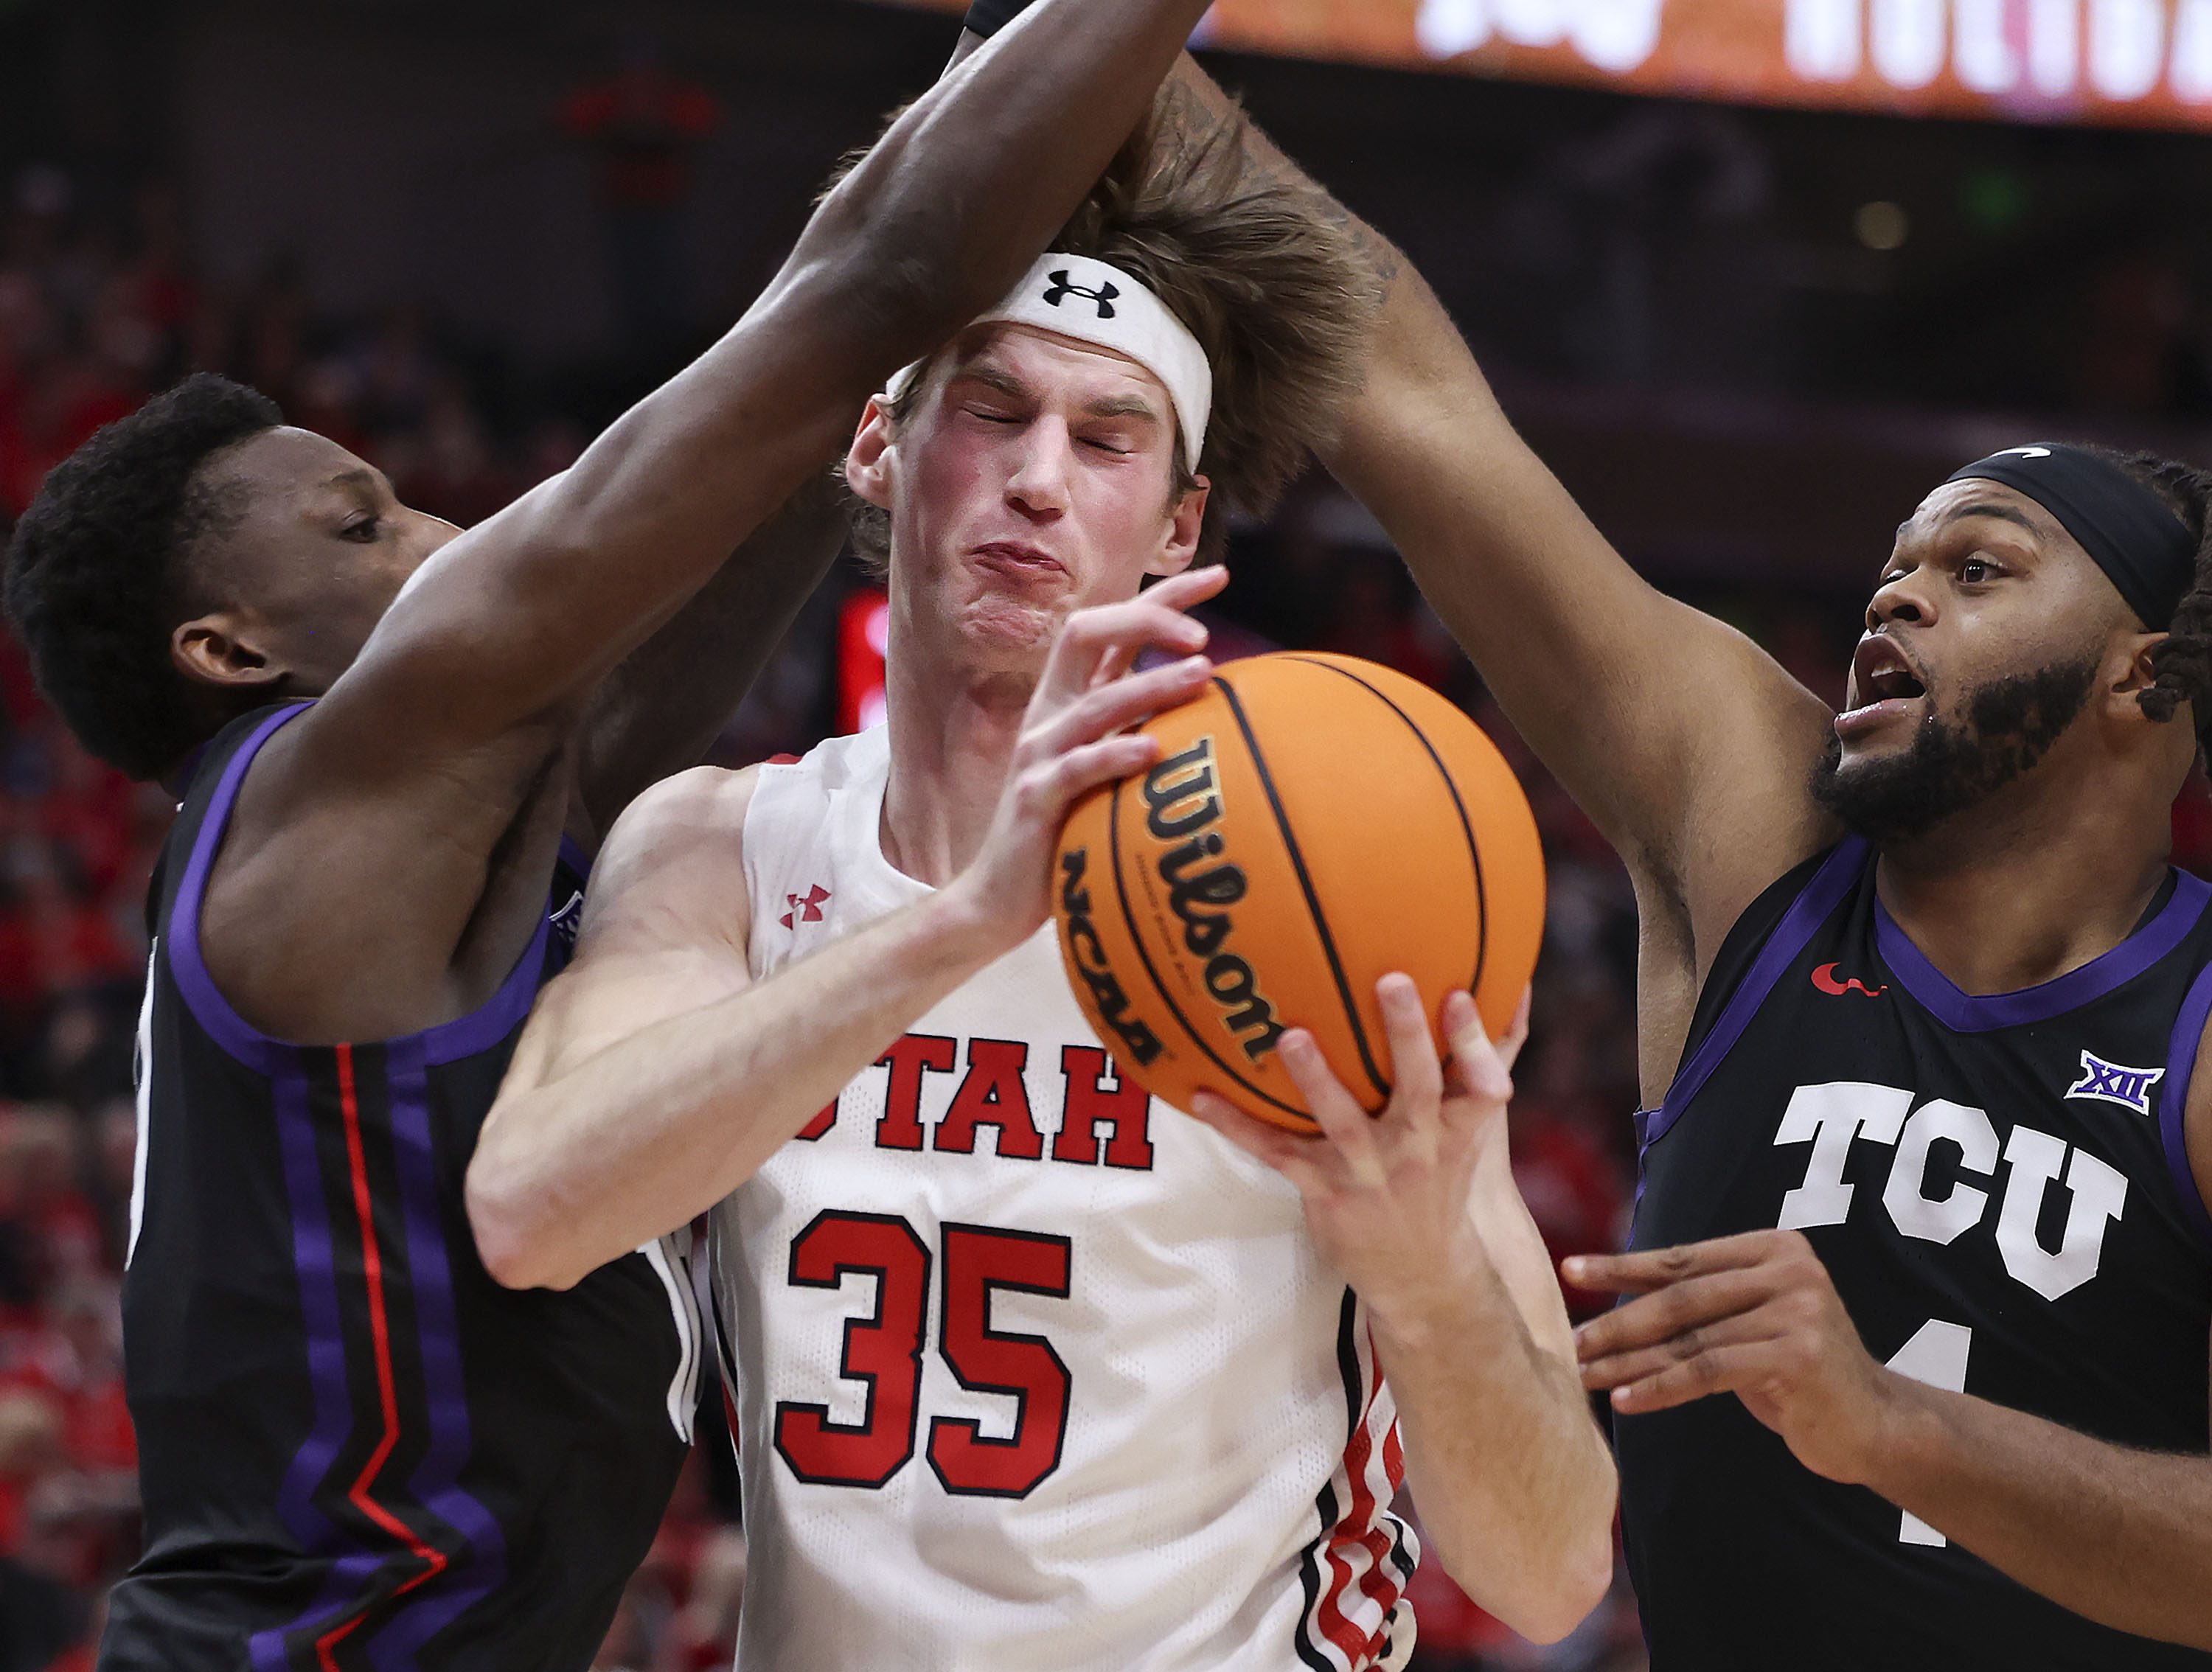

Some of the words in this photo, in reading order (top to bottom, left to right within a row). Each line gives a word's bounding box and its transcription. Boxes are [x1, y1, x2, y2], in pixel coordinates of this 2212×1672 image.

[1062, 848, 1162, 1066] NCAA
[1141, 734, 1287, 1064] Wilson
[793, 1033, 1153, 1170] TAH
[1773, 1081, 2129, 1302] TCU
[2071, 1055, 2159, 1109] XII
[774, 1208, 1072, 1499] 35
